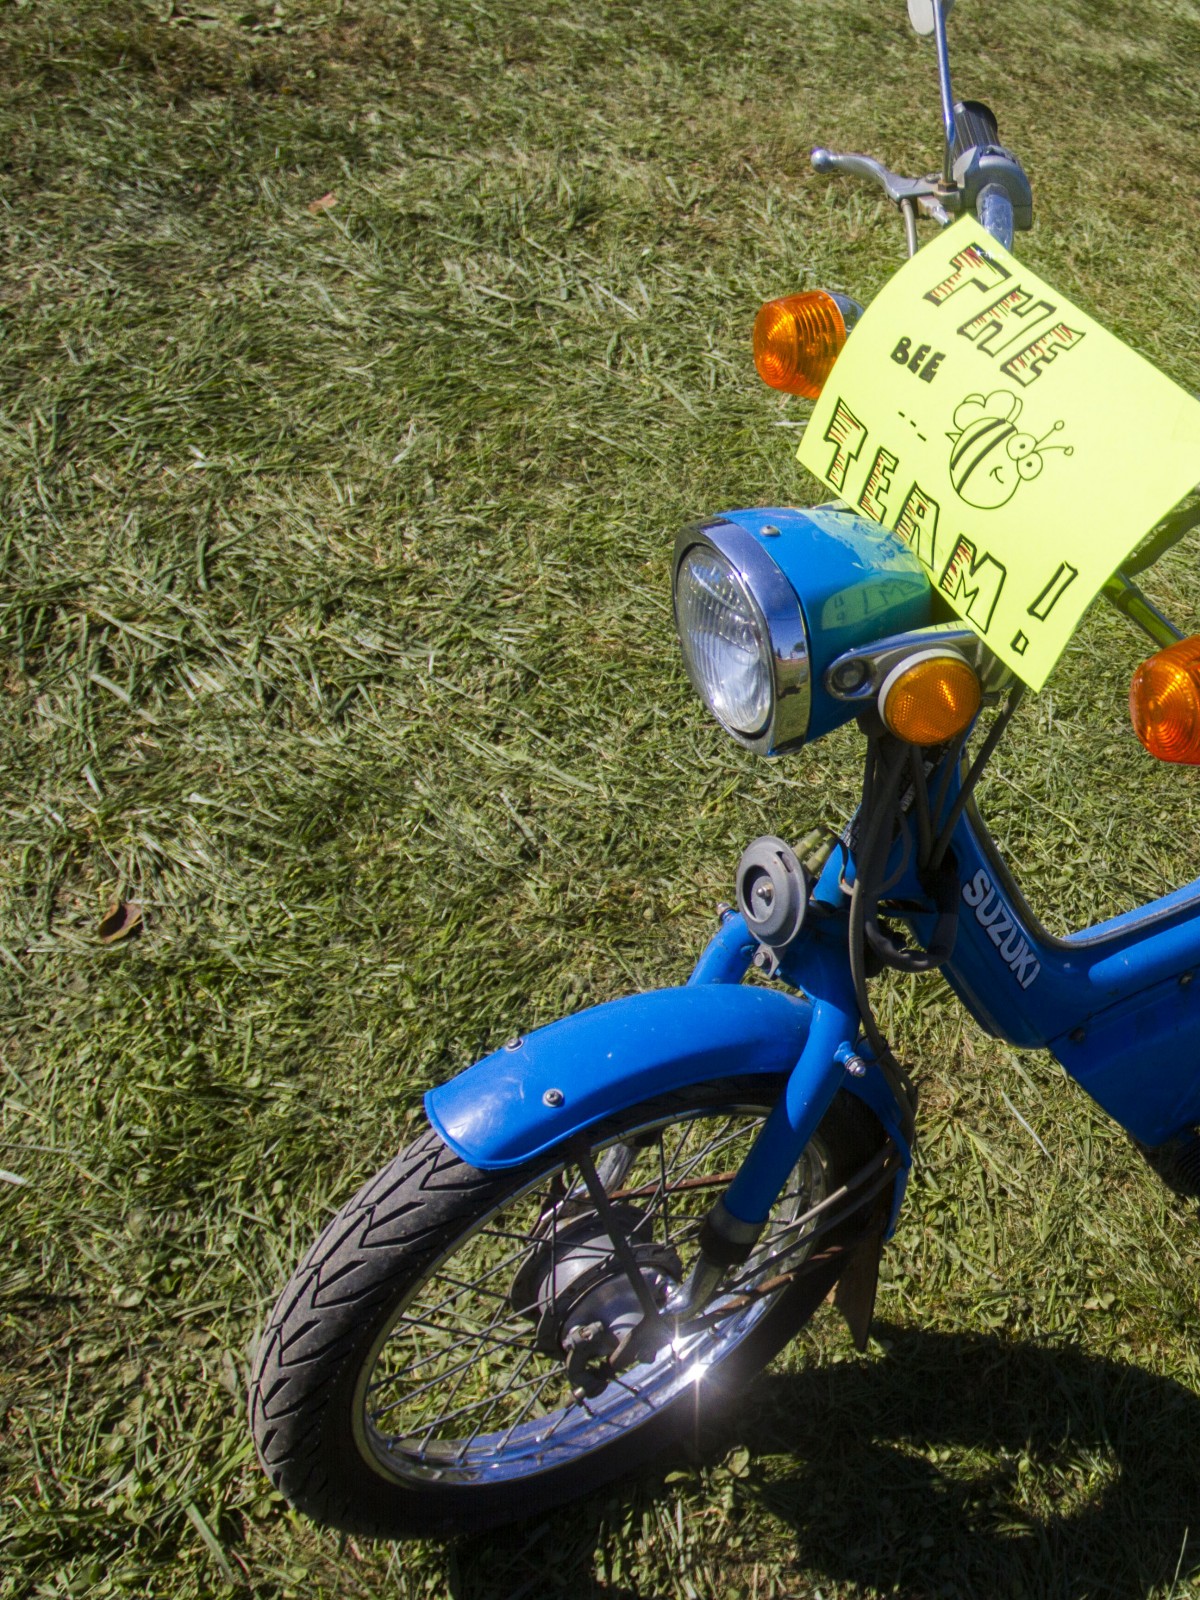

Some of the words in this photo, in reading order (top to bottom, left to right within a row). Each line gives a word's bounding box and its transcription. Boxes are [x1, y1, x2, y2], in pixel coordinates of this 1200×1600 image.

[891, 336, 946, 383] BEE
[923, 242, 1086, 387] THE
[823, 397, 1078, 656] TEAM!
[962, 868, 1042, 990] SUZUKI
